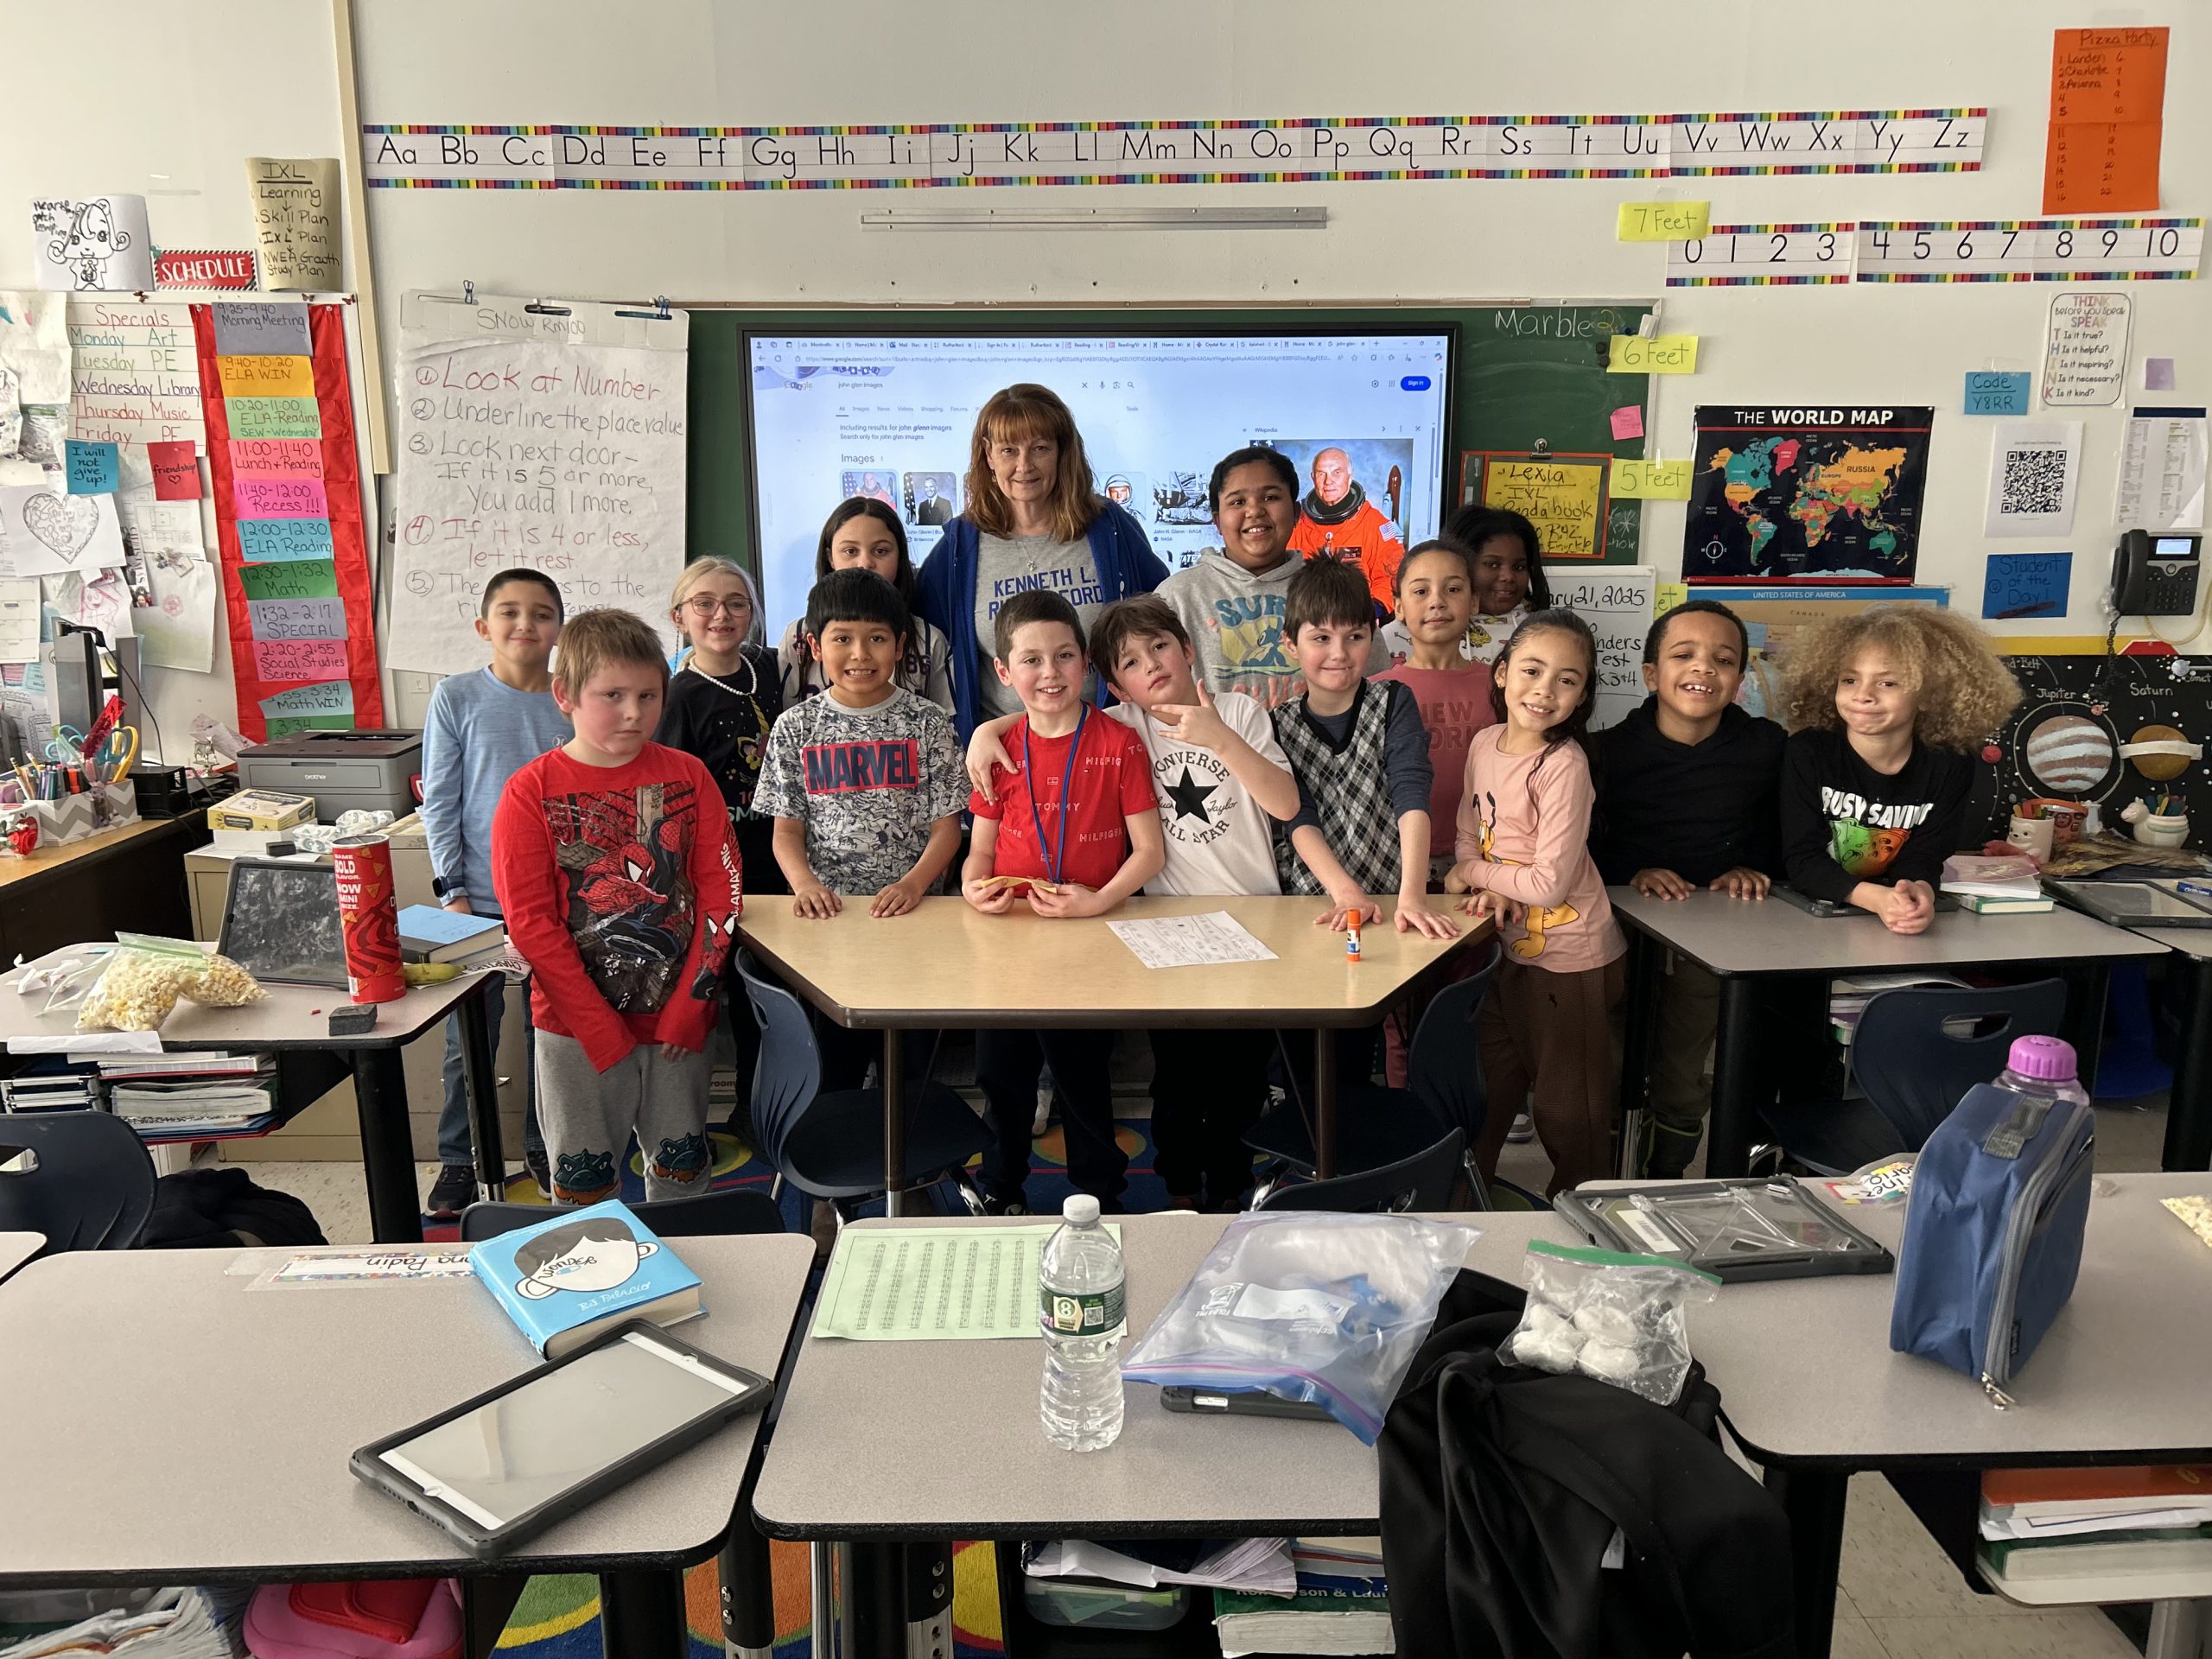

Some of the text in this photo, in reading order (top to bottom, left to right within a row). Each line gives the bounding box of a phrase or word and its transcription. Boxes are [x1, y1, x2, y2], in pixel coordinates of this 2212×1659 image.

[2080, 29, 2157, 48] Pizza Party
[377, 119, 1968, 179] Aa Bb Cc Dd Ee Ff Gg Hh Ii Jj Kk Ll Mm Nn Oo Pp Qq Rr Ss Tt Uu Vv Ww Xx Yy Zz
[261, 162, 305, 179] IXL
[261, 185, 321, 207] Learning
[260, 209, 328, 226] Skill Plan
[1633, 209, 1696, 232] 7 Feet
[262, 232, 327, 245] IXL Plan
[1685, 229, 2178, 262] 0 1 2 3 4 5 6 7 8 9 10
[264, 251, 296, 264] NWEA
[162, 257, 246, 283] SCHEDULE
[268, 264, 324, 277] Study Plan
[2073, 296, 2110, 307] THINK
[95, 303, 169, 331] Specials
[221, 315, 306, 333] Morning Meeting
[477, 308, 535, 330] SNOW
[1496, 308, 1592, 338] Marble
[70, 327, 177, 353] Monday Art
[2063, 330, 2103, 340] Is it true?
[1624, 340, 1689, 365] 6 Feet
[73, 346, 178, 378] Tuesday PE
[226, 369, 290, 380] ELA WIN
[442, 357, 660, 400] Look at Number
[1973, 374, 2012, 389] Code
[71, 370, 200, 408] Wednesday Library
[76, 395, 190, 427] Thursday Music
[1973, 397, 2014, 410] Y8RR
[444, 396, 684, 441] Underline the place value
[1734, 410, 1894, 425] THE WORLD MAP
[73, 448, 105, 456] I will
[237, 442, 313, 457] 11:00-11:40
[441, 430, 501, 461] Look
[510, 440, 563, 463] next
[77, 458, 99, 467] not
[235, 458, 272, 471] Lunch
[281, 456, 321, 478] Reading
[842, 453, 875, 464] Images
[74, 467, 100, 481] give
[152, 464, 196, 474] friendship!
[1510, 465, 1565, 483] Lexia
[1620, 463, 1685, 492] 5 Feet
[86, 475, 106, 487] up!
[248, 495, 320, 513] Recess !!!
[467, 484, 506, 514] You
[515, 490, 555, 514] add
[570, 490, 575, 514] 1
[468, 543, 505, 570] let
[512, 549, 528, 569] it
[1999, 555, 2062, 575] Student
[265, 581, 308, 596] Math
[995, 567, 1096, 597] KENNETH L.
[2008, 574, 2050, 587] of the
[1602, 586, 1645, 607] 2025
[1216, 594, 1286, 626] SUR
[267, 622, 339, 639] SPECIAL
[263, 669, 311, 680] Science
[2037, 688, 2077, 700] Jupiter
[2130, 683, 2173, 696] Saturn
[807, 744, 916, 791] MARVEL
[1154, 751, 1230, 782] CONVERSE
[1207, 797, 1238, 815] Taylor
[1161, 817, 1230, 844] ALL STAR
[334, 859, 356, 874] BOLD
[337, 883, 361, 893] NOW
[340, 894, 358, 903] MINI
